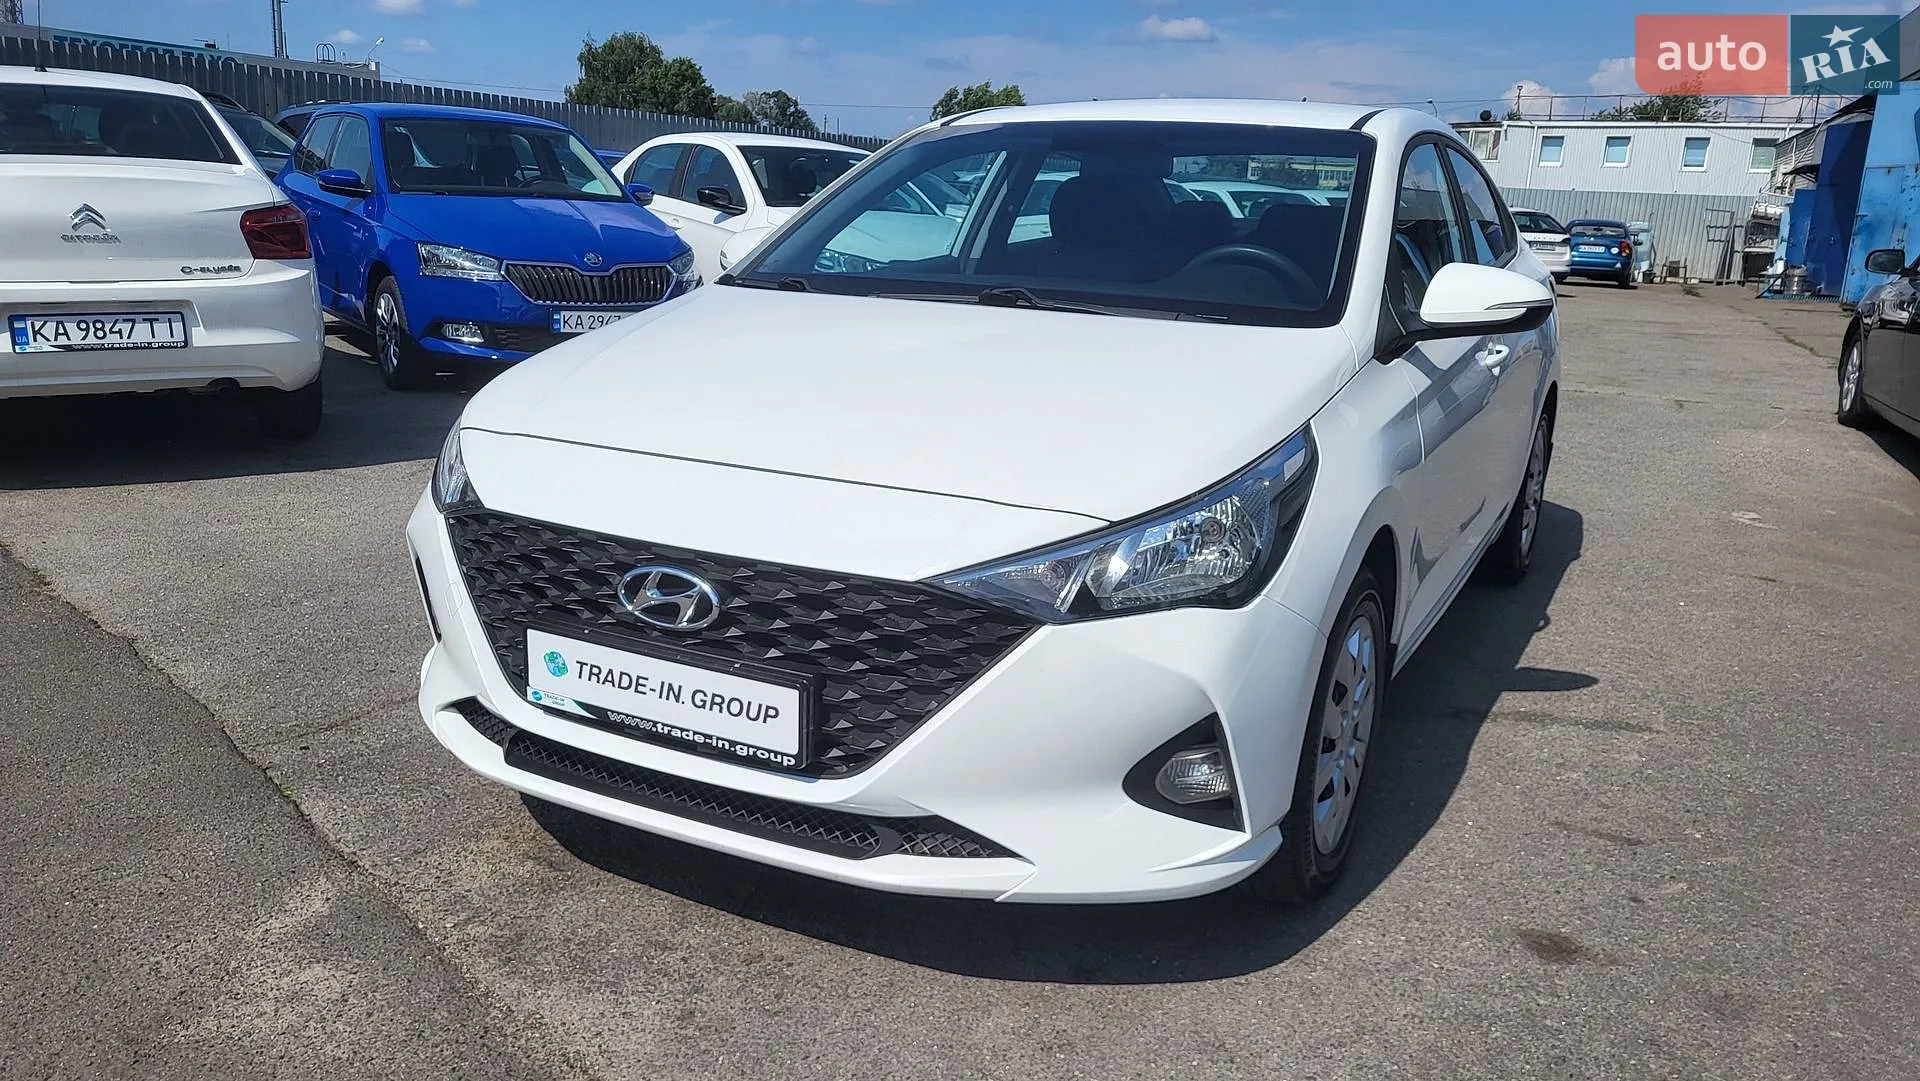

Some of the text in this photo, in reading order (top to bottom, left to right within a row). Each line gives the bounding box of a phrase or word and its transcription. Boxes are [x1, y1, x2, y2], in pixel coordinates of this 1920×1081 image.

[31, 317, 174, 342] KA 9847 TI
[563, 314, 584, 329] KA
[15, 335, 28, 343] UA
[690, 688, 780, 724] GROUP
[607, 710, 796, 767] www.trade-in.group
